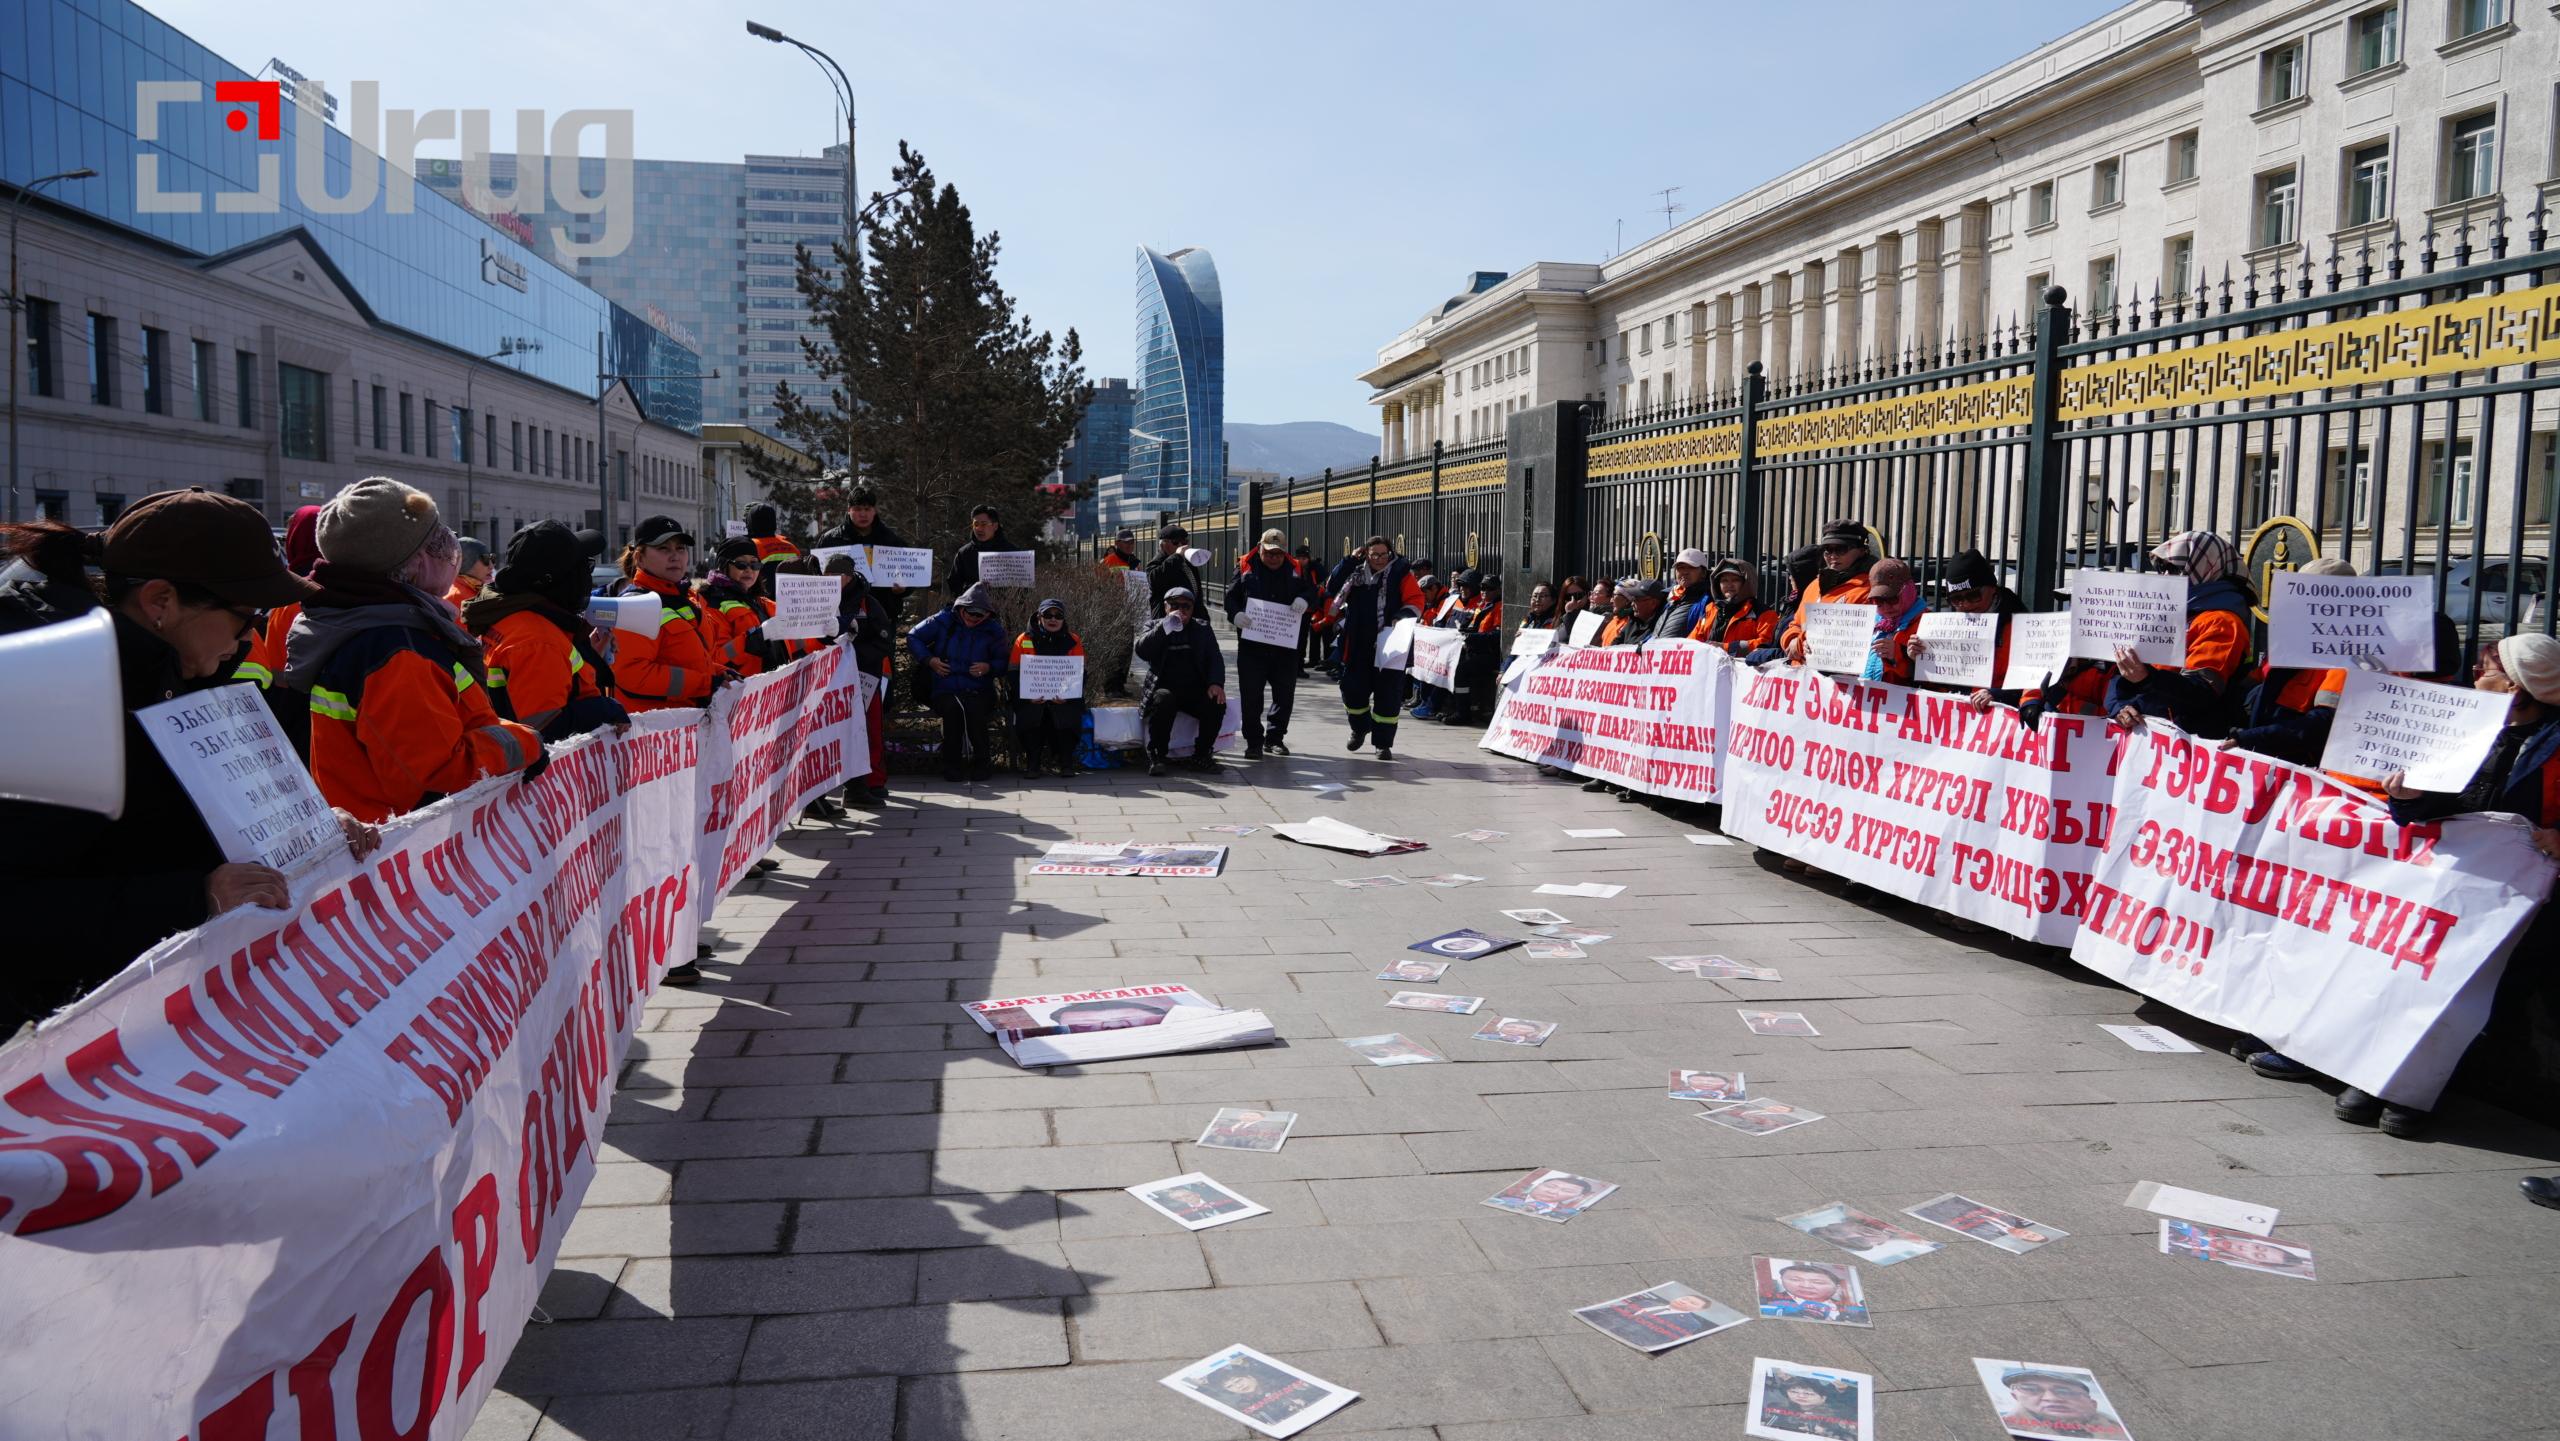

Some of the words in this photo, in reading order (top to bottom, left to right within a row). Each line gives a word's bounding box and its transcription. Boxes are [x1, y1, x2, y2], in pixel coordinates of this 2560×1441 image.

[2086, 587, 2114, 596] АЛБАН
[2117, 589, 2170, 600] ТУШААЛАА
[2288, 582, 2412, 598] 70.000.000.000
[2079, 597, 2124, 607] УРВУУЛАН
[2127, 601, 2178, 612] АШИГЛАЖ
[2307, 603, 2391, 617] ТӨГРӨГ
[2129, 612, 2167, 622] ТЭРБУМ
[2079, 618, 2109, 627] ТӨГРӨГ
[2112, 621, 2176, 634] ХУЛГАЙЛСАН
[2311, 622, 2385, 637] ХААНА
[1960, 643, 1980, 651] БУС
[2312, 640, 2386, 656] БАЙНА
[1650, 686, 1677, 711] ТҮР
[2377, 682, 2479, 710] ЭНХТАЙВАНЫ
[2390, 700, 2456, 720] БАТБАЯР
[2364, 711, 2400, 726] 24500
[2354, 754, 2368, 766] 70
[422, 832, 501, 918] ЧИ
[472, 797, 532, 886] 70
[505, 740, 610, 858] ТЭРБУМЫГ
[611, 728, 681, 798] ЗАВШСАН
[1765, 789, 1842, 845] ЭЦСЭЭ
[1844, 814, 1940, 877] ХҮРТЭЛ
[1804, 741, 1884, 795] ТӨЛӨХ
[1886, 762, 1992, 823] ХҮРТЭЛ
[2130, 820, 2458, 981] ЭЗЭМШИГЧИД
[969, 984, 1189, 1012] Э.БАТ-АМГАЛАН
[384, 901, 549, 1128] БАРИМТААР
